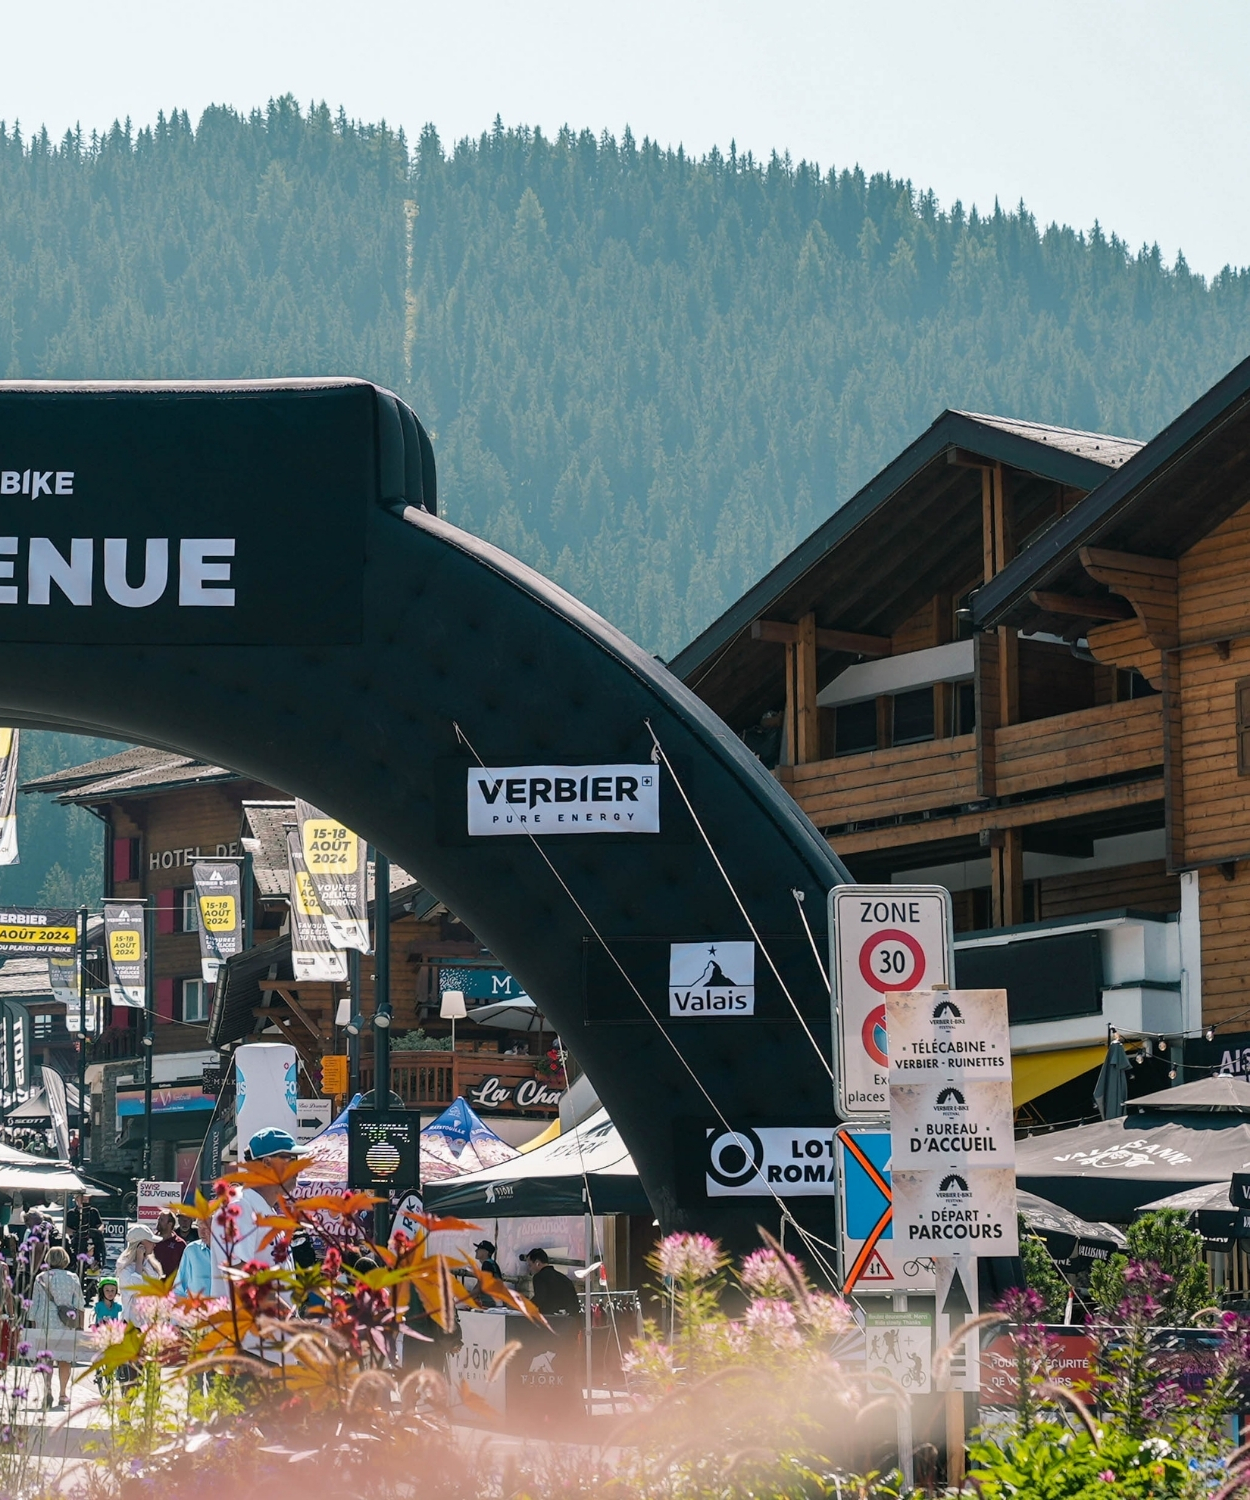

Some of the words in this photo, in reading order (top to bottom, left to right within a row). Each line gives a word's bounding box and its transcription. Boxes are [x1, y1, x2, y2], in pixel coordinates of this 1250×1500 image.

[478, 775, 639, 810] VERBIER
[493, 814, 541, 823] PURE
[558, 813, 635, 822] ENERGY
[313, 828, 346, 839] 15-18
[310, 838, 351, 851] AOÛT
[150, 847, 205, 870] HOTEL
[313, 853, 347, 864] 2024
[205, 909, 231, 917] AOÛT
[860, 902, 920, 923] ZONE
[38, 931, 70, 941] 2024
[8, 944, 36, 952] PLAISIR
[48, 945, 71, 953] E-BIKE
[879, 950, 905, 973] 30
[674, 989, 747, 1011] Valais
[911, 1039, 986, 1054] TÉLÉCABINE
[895, 1058, 939, 1069] VERBIER
[948, 1056, 1005, 1068] RUINETTES
[472, 1077, 511, 1107] La
[848, 1090, 885, 1105] places
[926, 1123, 978, 1135] BUREAU
[910, 1137, 997, 1152] D'ACCUEIL
[1053, 1139, 1193, 1166] VALAISANNE
[931, 1207, 979, 1222] DÉPART
[909, 1223, 1003, 1239] PARCOURS
[991, 1359, 1018, 1368] POUR
[991, 1377, 1005, 1385] DE
